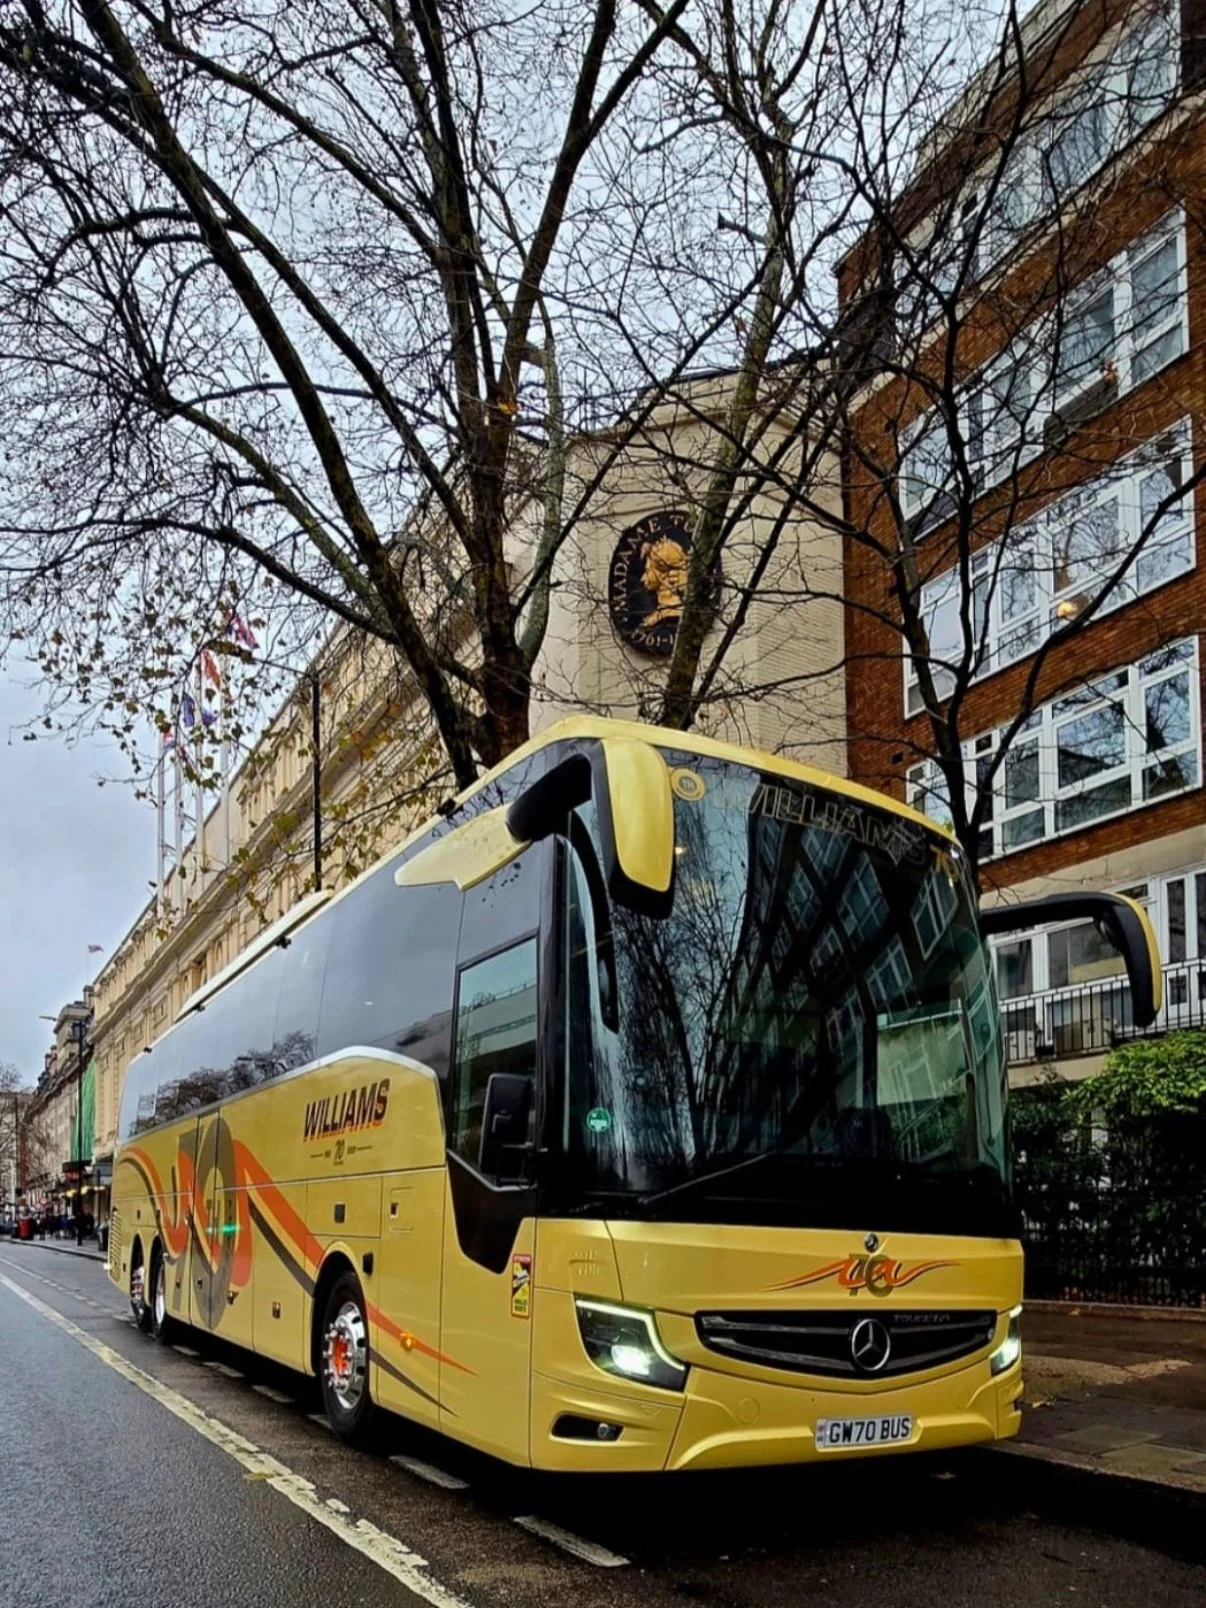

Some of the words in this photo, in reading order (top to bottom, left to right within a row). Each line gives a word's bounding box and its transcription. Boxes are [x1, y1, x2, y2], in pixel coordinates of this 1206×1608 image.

[613, 517, 661, 613] MADAME
[303, 1079, 390, 1140] WILLIAMS
[829, 1420, 876, 1443] GW70
[880, 1417, 910, 1440] BUS
